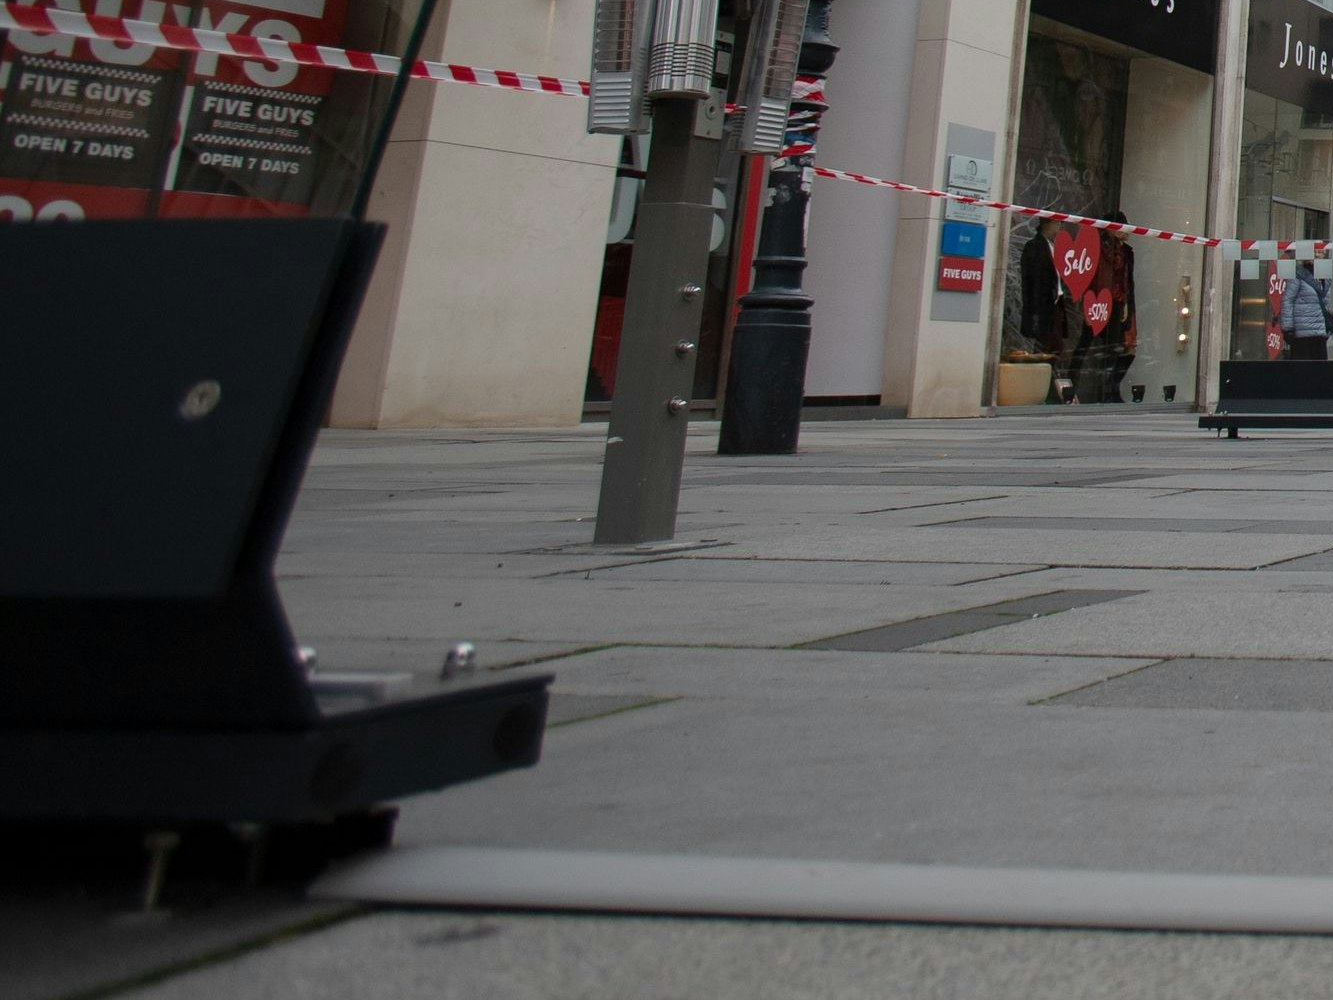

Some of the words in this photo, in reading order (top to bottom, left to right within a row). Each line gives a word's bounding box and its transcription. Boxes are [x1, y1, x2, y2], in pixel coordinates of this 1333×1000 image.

[19, 73, 78, 98] FIVE
[85, 80, 153, 107] GUYS
[202, 95, 252, 118] FIVE
[256, 103, 316, 126] GUYS
[14, 134, 66, 154] OPEN
[72, 139, 84, 154] 7
[87, 140, 135, 160] DAYS
[200, 151, 244, 169] OPEN
[247, 157, 257, 170] 7
[261, 158, 300, 175] DAYS
[943, 268, 961, 279] FIVE
[961, 269, 982, 281] GUYS
[1063, 247, 1094, 277] Sale
